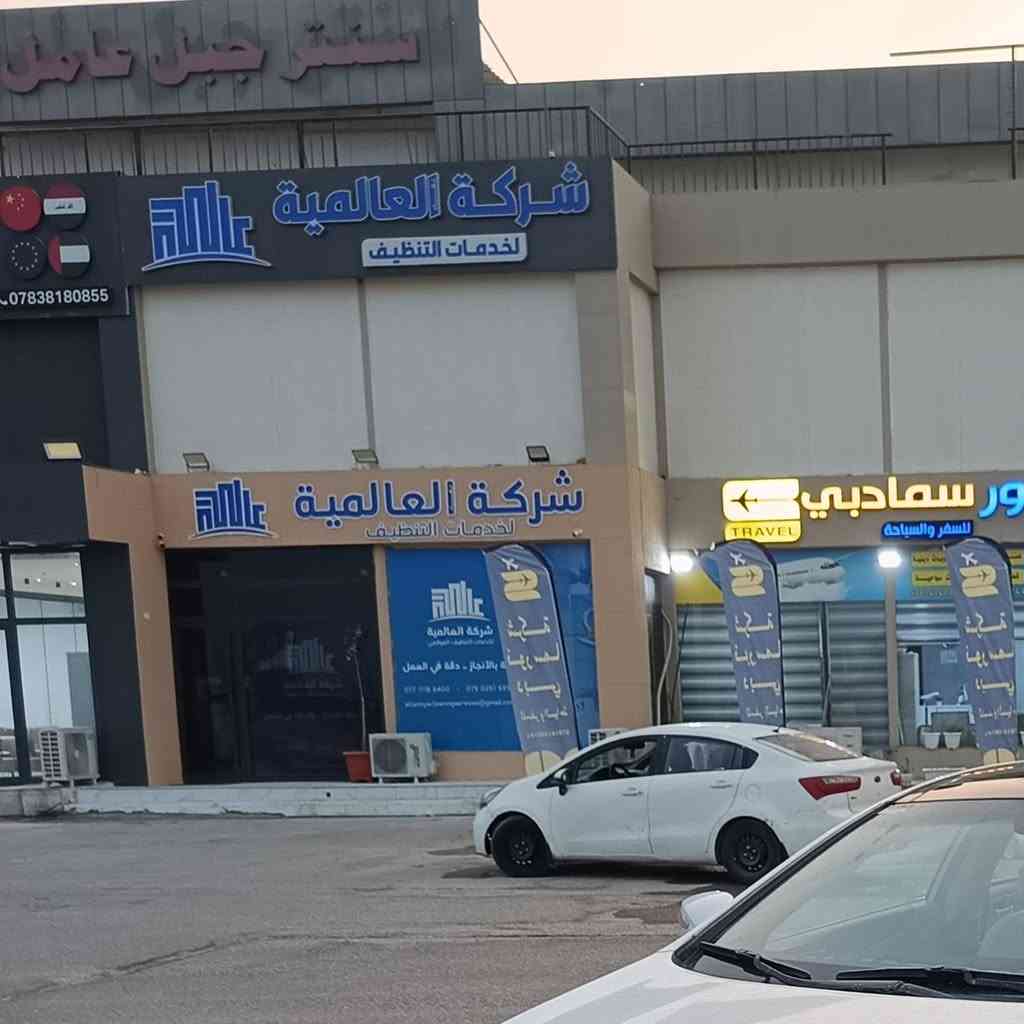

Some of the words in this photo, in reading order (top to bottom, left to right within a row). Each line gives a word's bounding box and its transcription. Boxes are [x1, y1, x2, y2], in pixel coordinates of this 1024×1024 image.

[153, 29, 265, 86] جبل
[448, 161, 589, 227] شركة
[273, 172, 439, 236] العالمية
[368, 239, 441, 264] التنظيف
[445, 237, 520, 259] لخدمات
[9, 288, 109, 305] 07838180855
[295, 480, 455, 528] العالمية
[468, 469, 583, 526] شركة
[365, 522, 437, 541] التنظيف
[445, 519, 516, 538] لخدمات
[731, 526, 795, 538] TRAVEL
[884, 522, 935, 538] والسياحة
[937, 522, 971, 539] للسفر
[427, 626, 464, 639] العالمية
[466, 624, 493, 638] شركة
